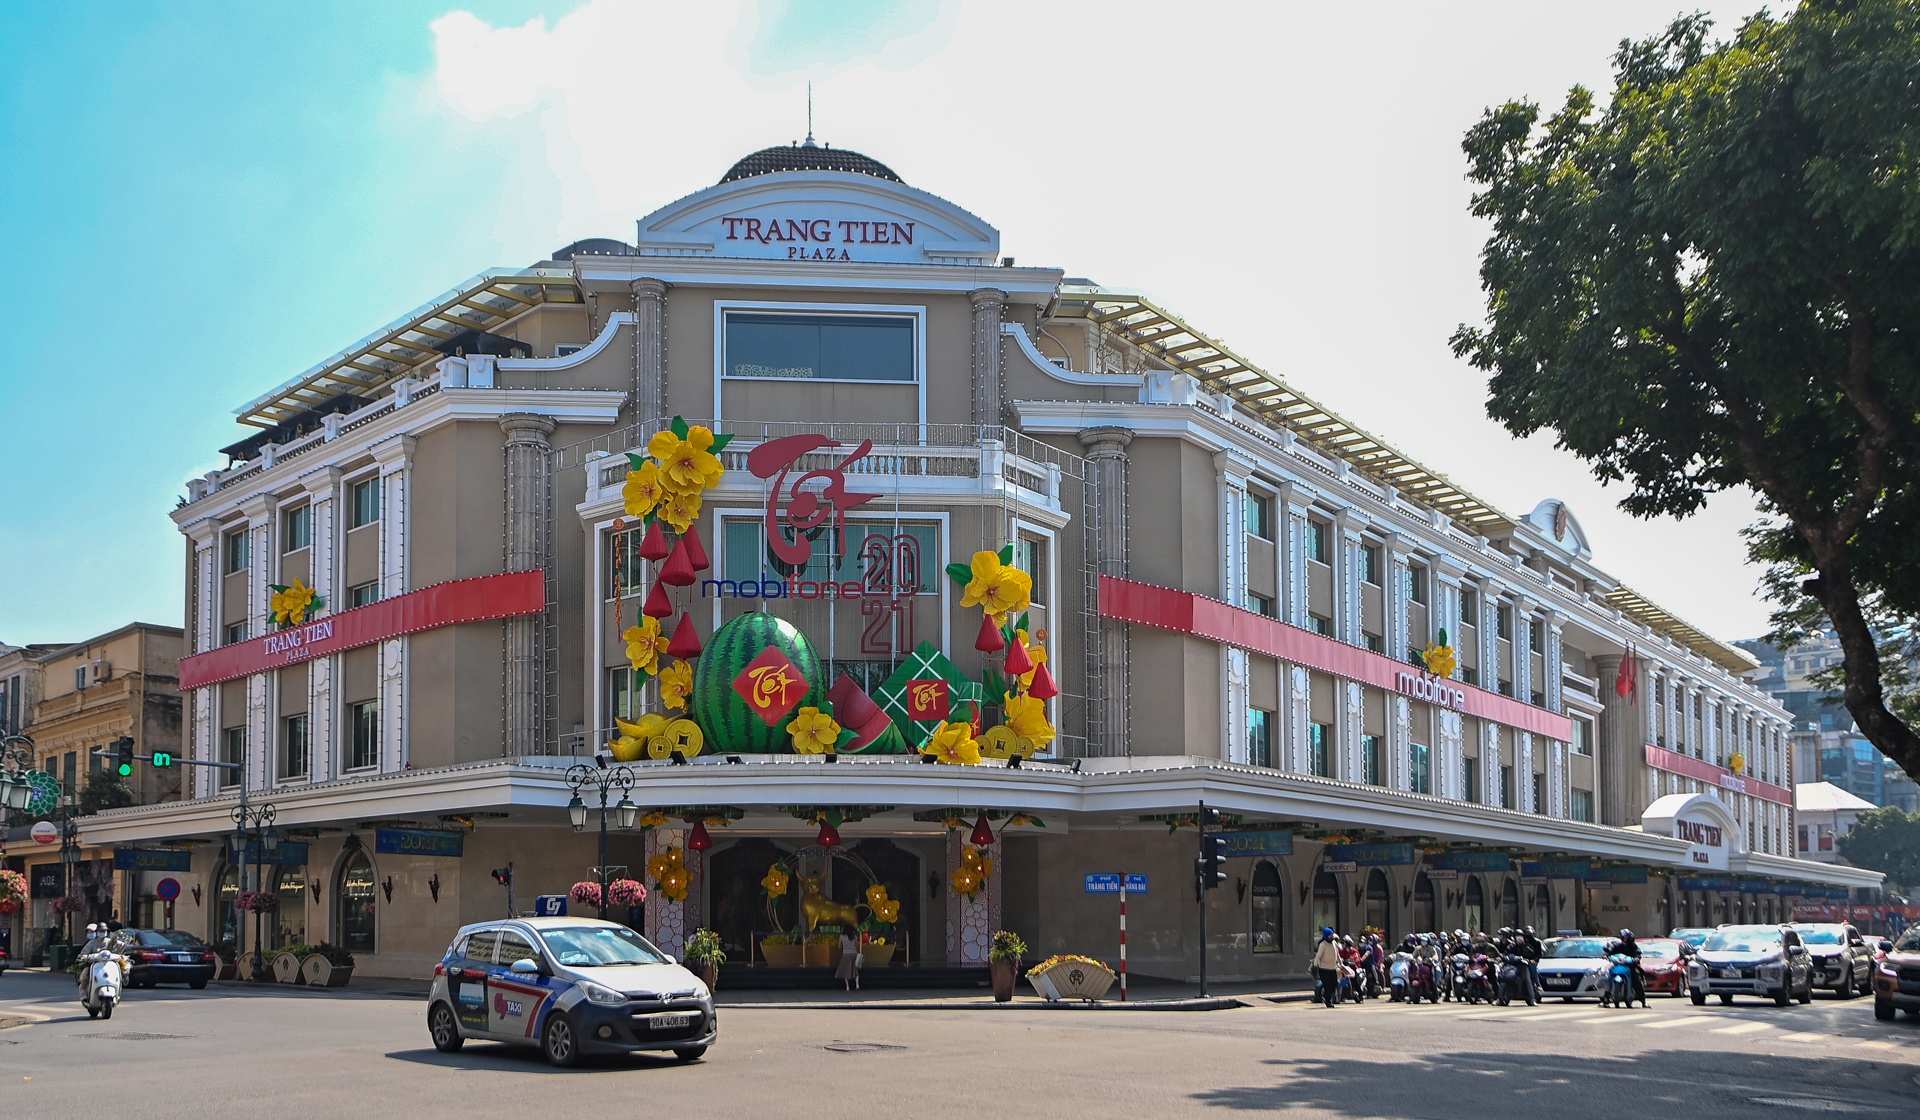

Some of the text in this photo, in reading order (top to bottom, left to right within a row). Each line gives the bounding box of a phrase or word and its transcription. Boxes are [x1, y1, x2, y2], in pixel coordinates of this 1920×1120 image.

[722, 217, 915, 245] TRANG TIEN
[788, 246, 851, 260] PLAZA
[701, 572, 862, 599] mobifone
[263, 620, 334, 655] TRANG TIEN
[286, 646, 310, 660] PLAZA
[1399, 670, 1465, 710] mobifone
[153, 752, 170, 766] 07
[1677, 819, 1722, 847] TRANG TIEN
[401, 834, 438, 851] 2021
[1692, 851, 1709, 863] PLAZA
[507, 1001, 522, 1013] TAXI
